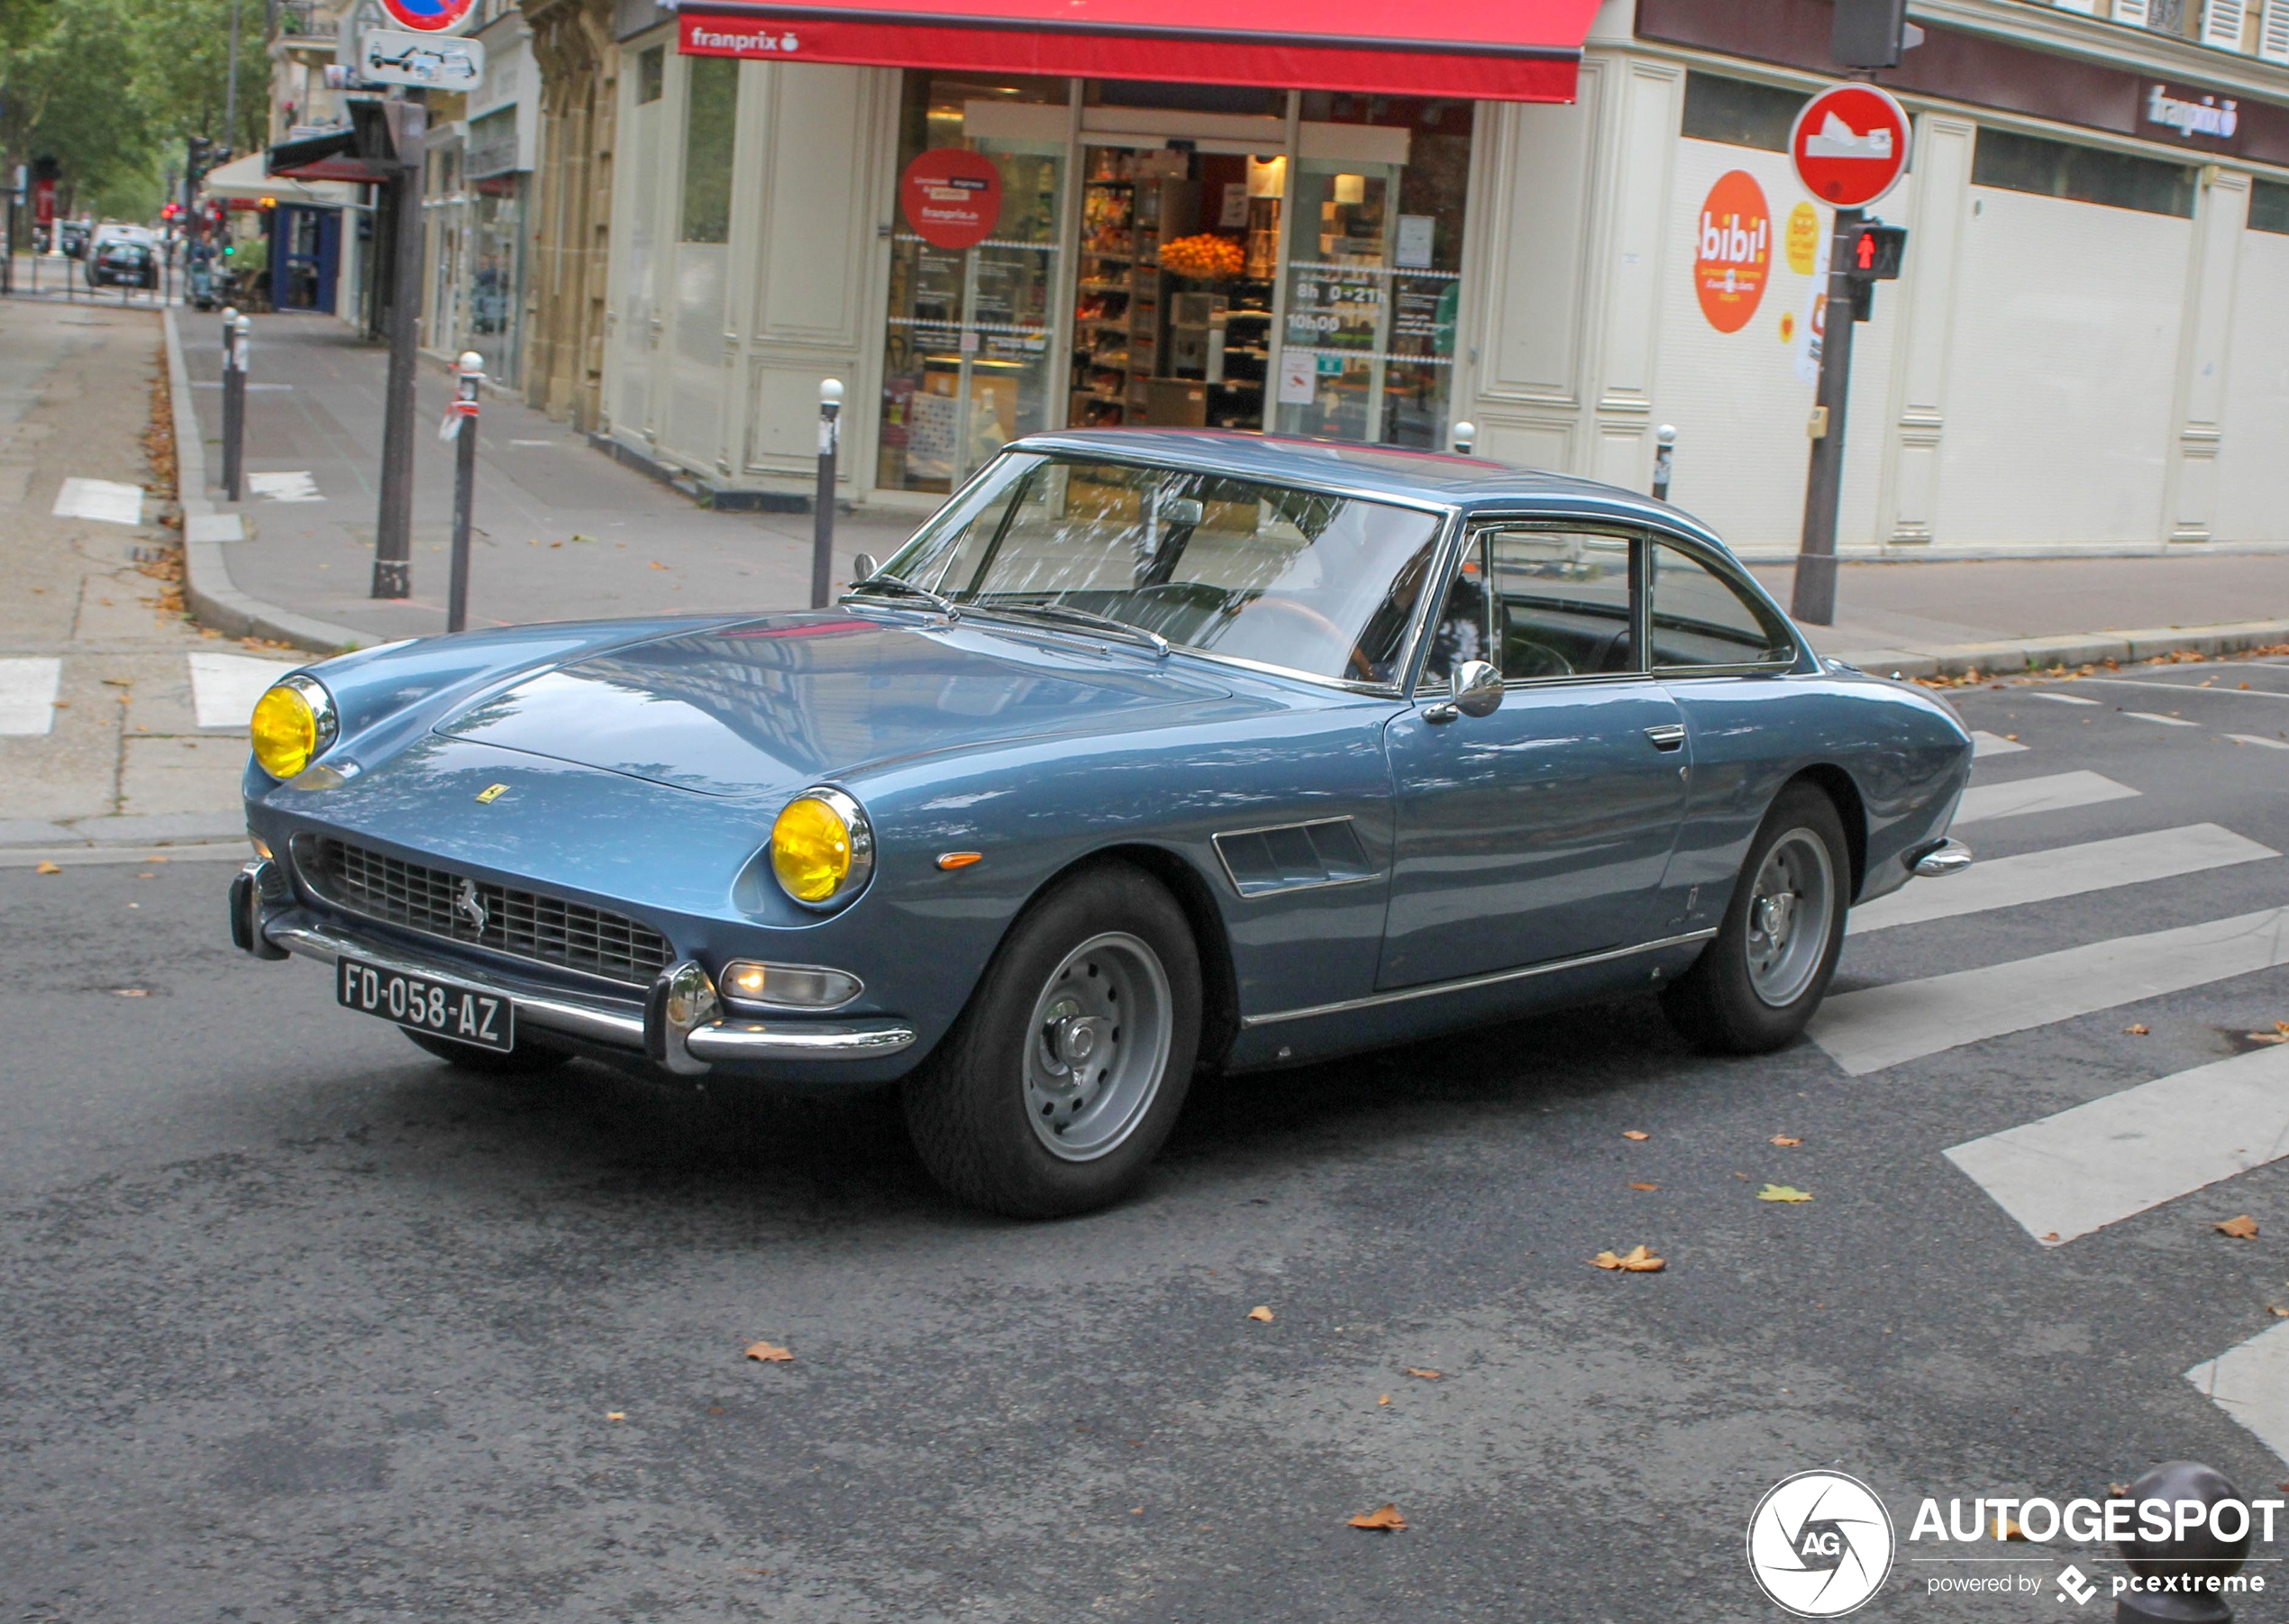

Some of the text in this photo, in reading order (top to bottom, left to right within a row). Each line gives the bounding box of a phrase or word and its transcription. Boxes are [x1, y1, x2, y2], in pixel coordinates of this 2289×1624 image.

[691, 27, 777, 52] franprix
[2148, 85, 2221, 137] franprix
[1701, 211, 1767, 263] bibi!
[345, 963, 499, 1041] FD-058-AZ
